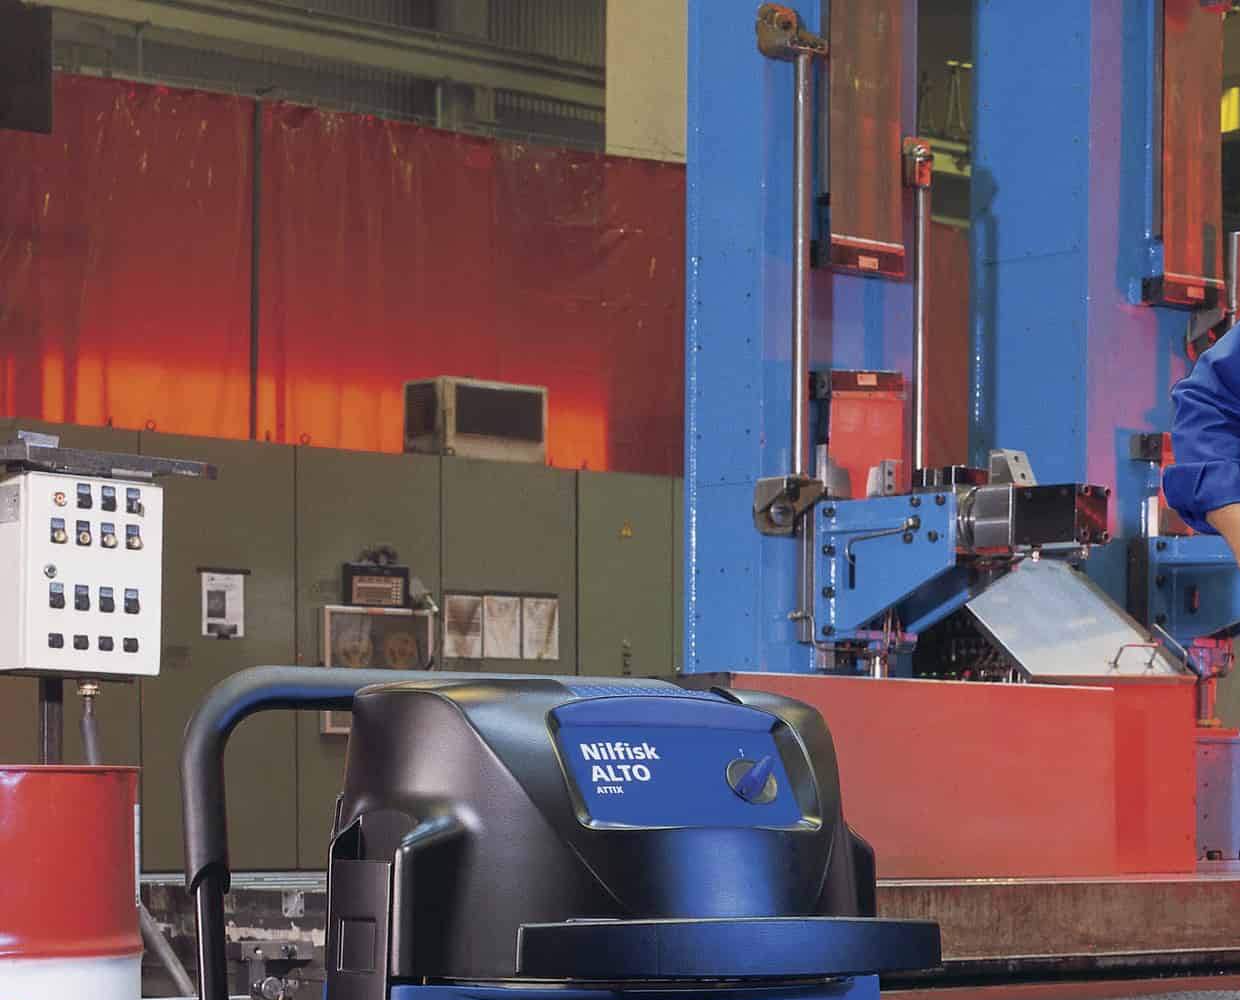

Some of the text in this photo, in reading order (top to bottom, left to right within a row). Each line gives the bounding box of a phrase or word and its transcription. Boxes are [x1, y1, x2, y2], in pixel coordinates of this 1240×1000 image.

[579, 742, 660, 760] Nilfisk
[592, 764, 651, 782] ALTO
[596, 786, 624, 794] ATTIX
